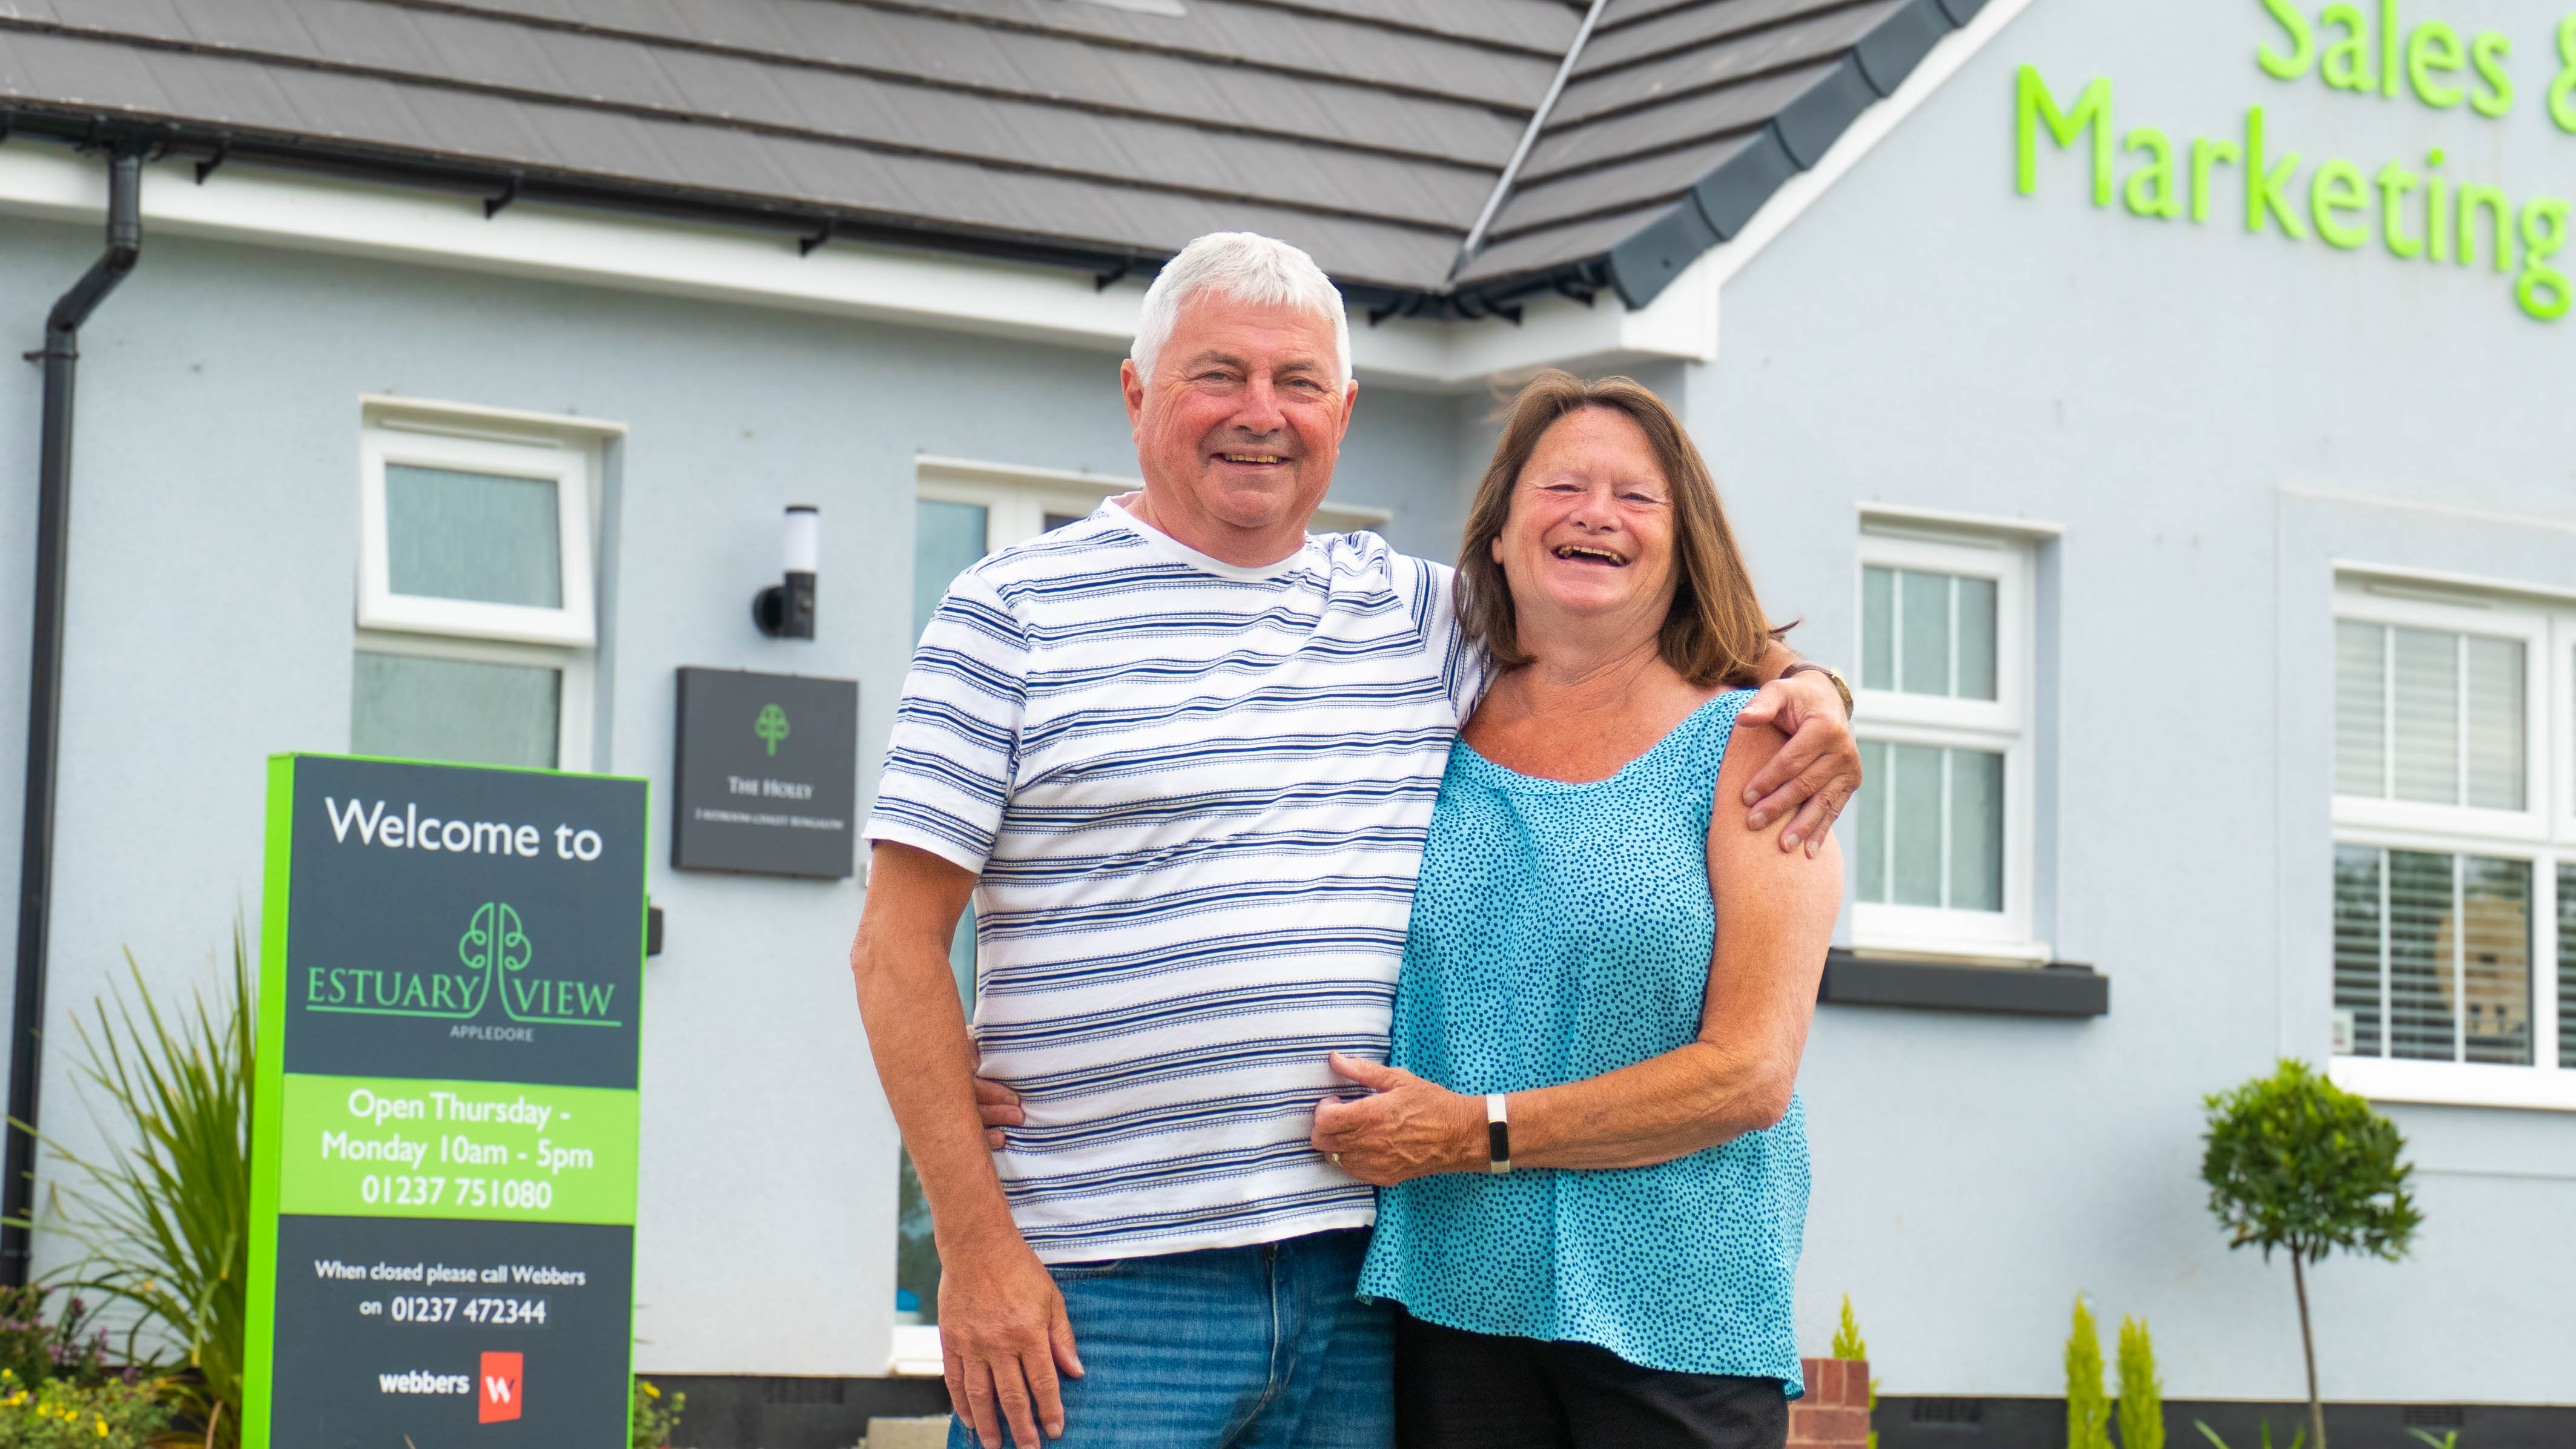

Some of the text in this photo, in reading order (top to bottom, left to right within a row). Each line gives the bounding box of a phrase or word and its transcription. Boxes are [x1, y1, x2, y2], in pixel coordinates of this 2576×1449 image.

[2258, 0, 2513, 117] Sales
[2016, 64, 2574, 320] Marketing
[325, 797, 602, 860] Welcome to
[307, 967, 615, 1017] ESTUARY VIEW
[450, 1025, 534, 1043] APPLEDORE
[348, 1088, 424, 1126] Open
[429, 1091, 552, 1132] Thursday
[322, 1130, 428, 1170] Monday
[441, 1135, 508, 1164] 10am
[537, 1138, 593, 1175] 5pm
[362, 1174, 552, 1209] 01237 751080
[315, 1260, 586, 1286] When closed please call Webbers
[360, 1296, 546, 1324] on 01237 472344
[379, 1370, 470, 1394] webbers
